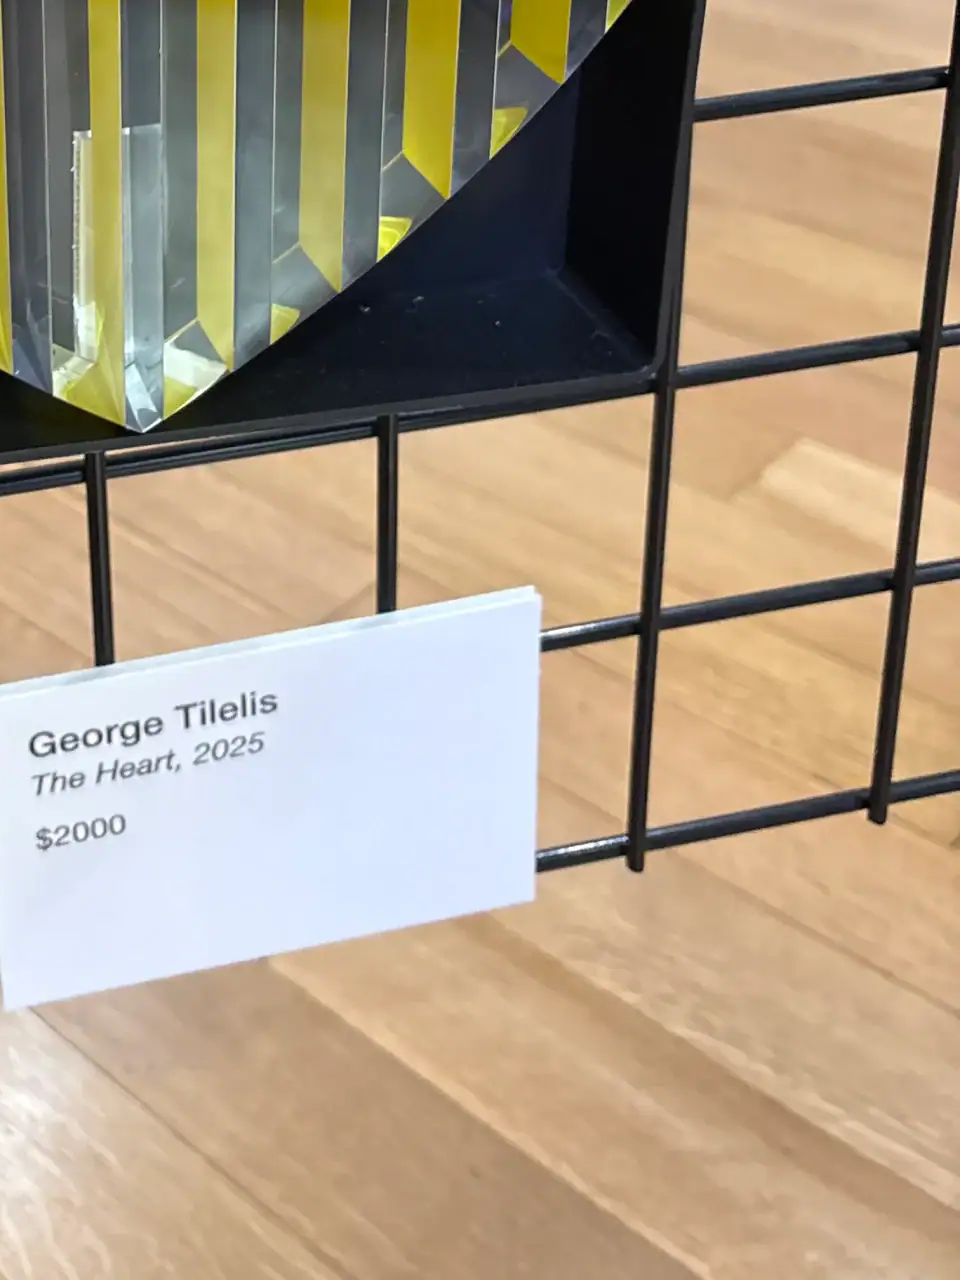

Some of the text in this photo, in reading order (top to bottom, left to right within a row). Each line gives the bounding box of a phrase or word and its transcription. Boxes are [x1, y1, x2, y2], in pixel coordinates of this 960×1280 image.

[28, 690, 279, 759] George Tilelis
[31, 730, 266, 797] The Heart, 2025
[35, 814, 127, 852] $2000
